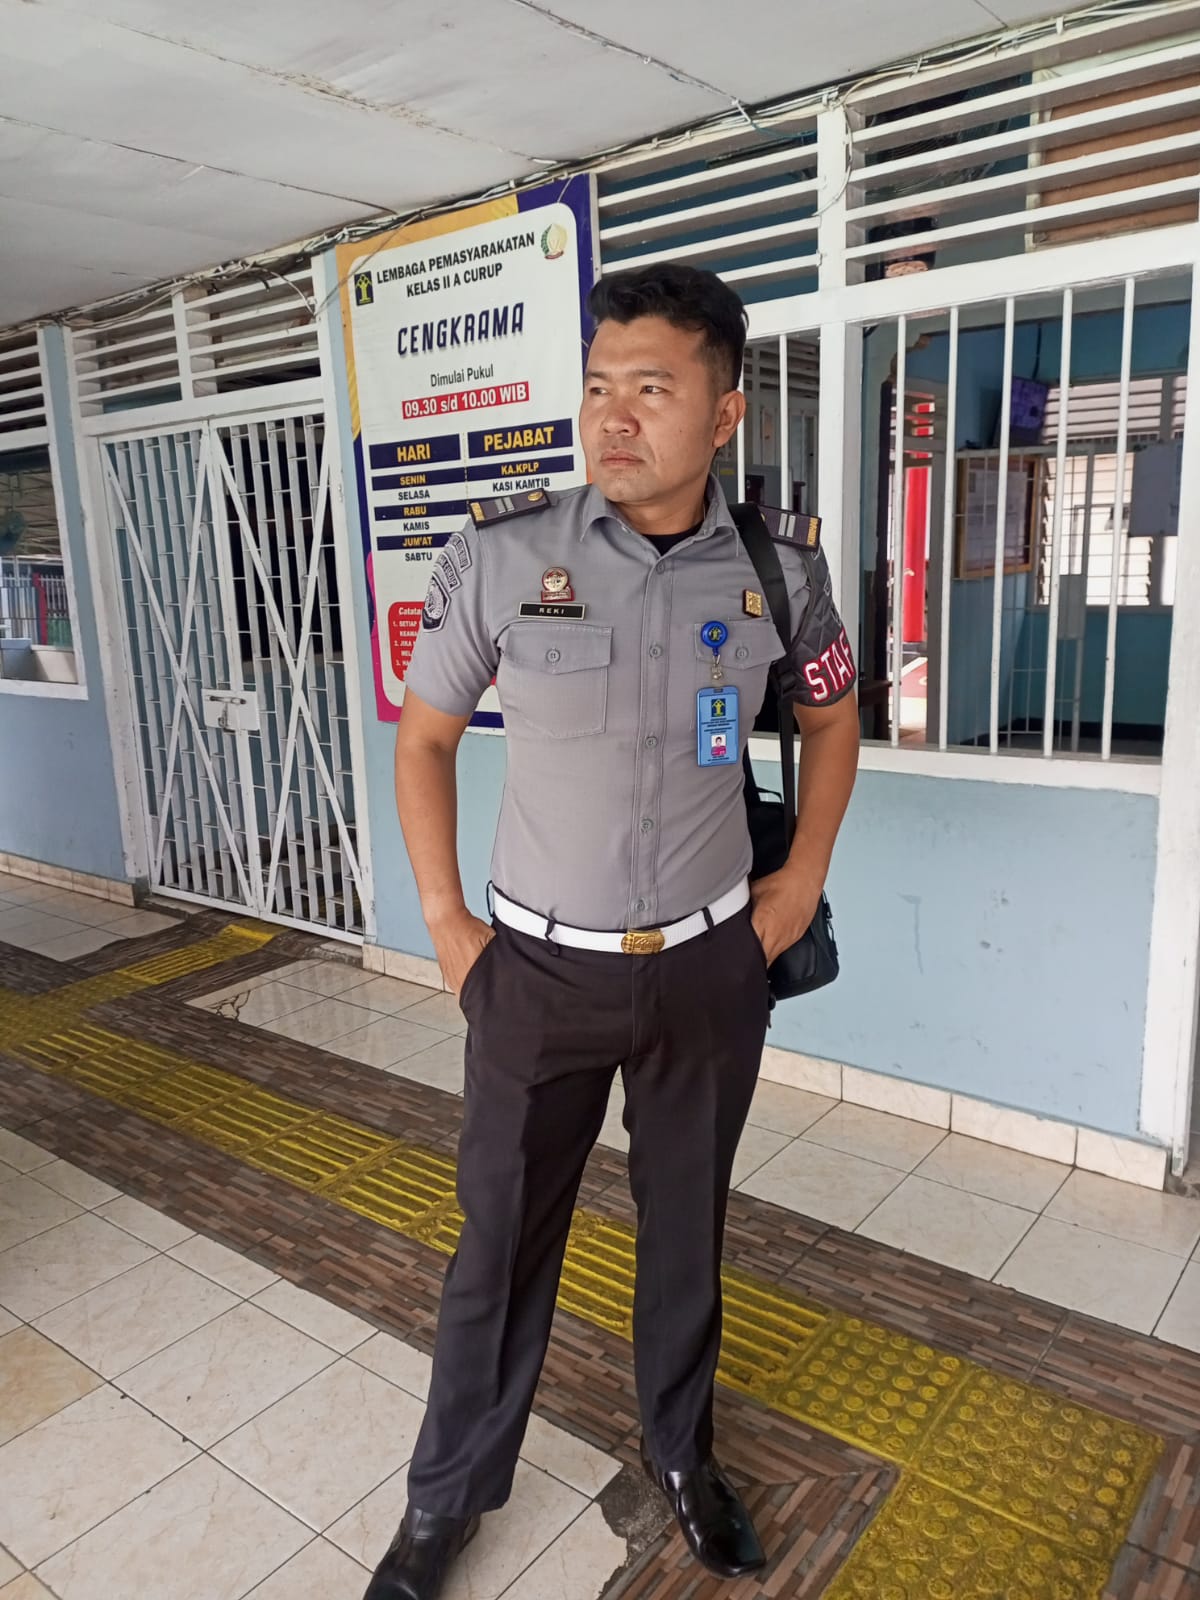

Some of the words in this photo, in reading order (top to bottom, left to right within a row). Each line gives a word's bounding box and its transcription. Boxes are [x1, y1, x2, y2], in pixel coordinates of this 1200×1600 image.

[377, 260, 426, 284] LEMBAGA
[429, 231, 535, 269] PEMASYARAKATAN
[406, 276, 440, 298] KELAS
[443, 275, 451, 289] II
[453, 273, 461, 287] A
[463, 262, 503, 284] CURUP
[397, 302, 525, 356] CENGKRAMA
[430, 369, 465, 387] Dimulai
[467, 364, 494, 382] Pukul
[404, 398, 437, 418] 09.30
[440, 393, 458, 413] s/d
[461, 389, 496, 409] 10.00
[499, 383, 527, 404] WIB
[483, 426, 555, 452] PEJABAT
[397, 443, 431, 463] HARI
[501, 462, 539, 476] KA.KPLP
[400, 474, 426, 486] SENIN
[492, 481, 513, 493] KASI
[515, 478, 550, 490] KAMTIB
[398, 489, 430, 502] SELASA
[403, 506, 427, 517] RABU
[403, 521, 430, 532] KAMIS
[402, 536, 433, 549] JUM'AT
[405, 551, 432, 562] SABTU
[539, 607, 565, 615] REKI
